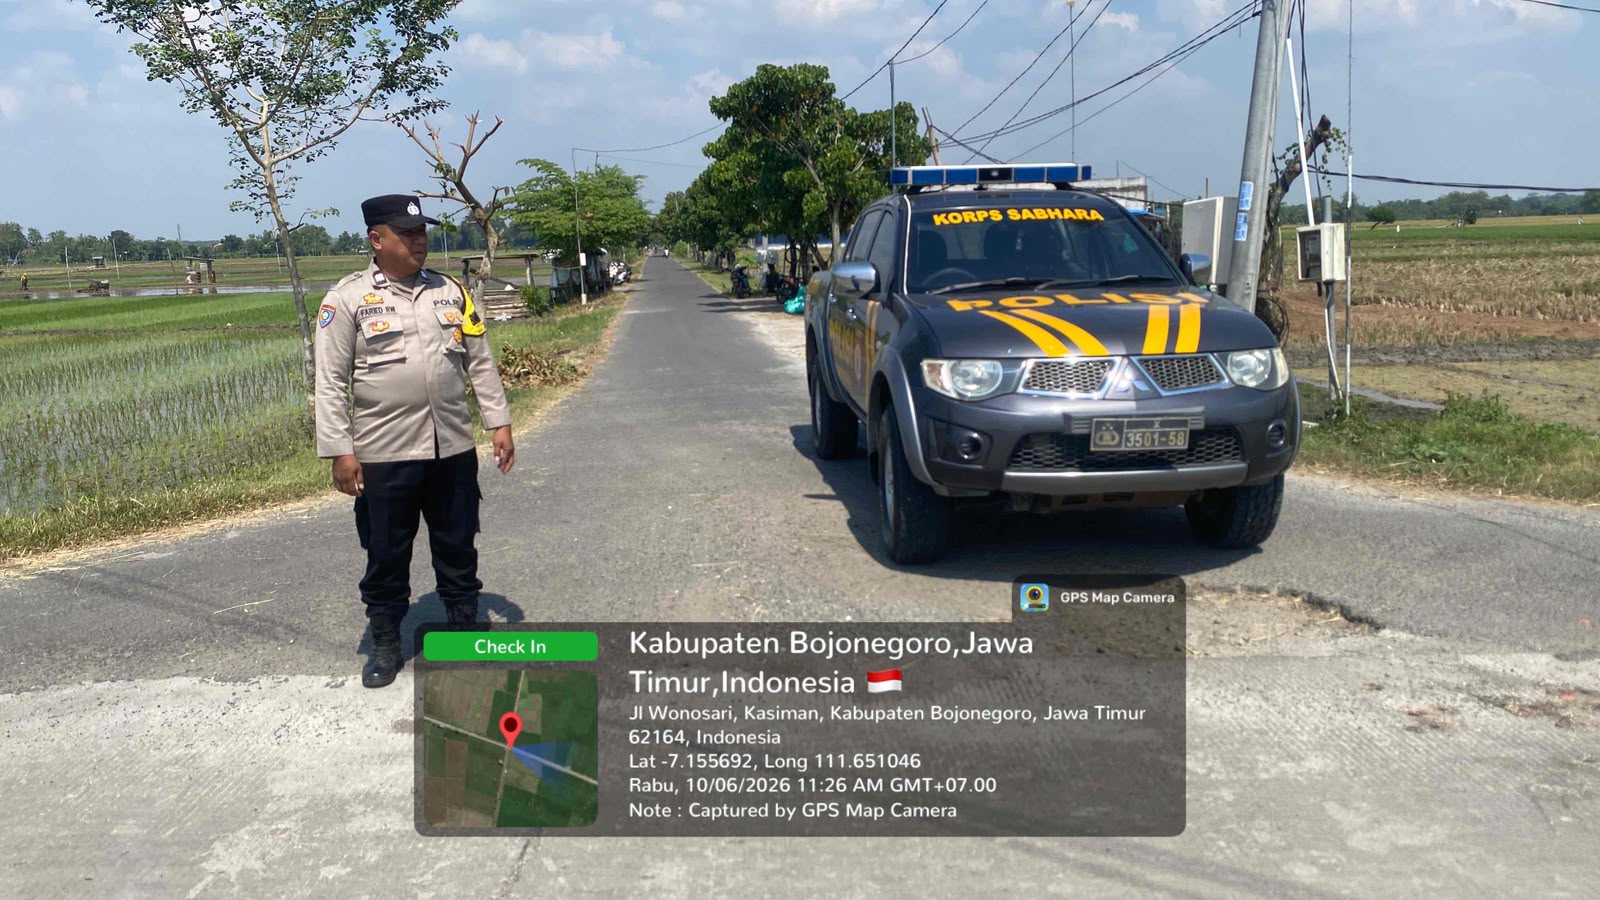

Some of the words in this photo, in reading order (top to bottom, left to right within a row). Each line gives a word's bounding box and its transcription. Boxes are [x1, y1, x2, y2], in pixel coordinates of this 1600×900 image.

[933, 209, 1003, 226] KORPS
[1007, 208, 1105, 221] SABHARA
[947, 293, 1209, 312] POLISI
[1126, 431, 1185, 447] 3501-58
